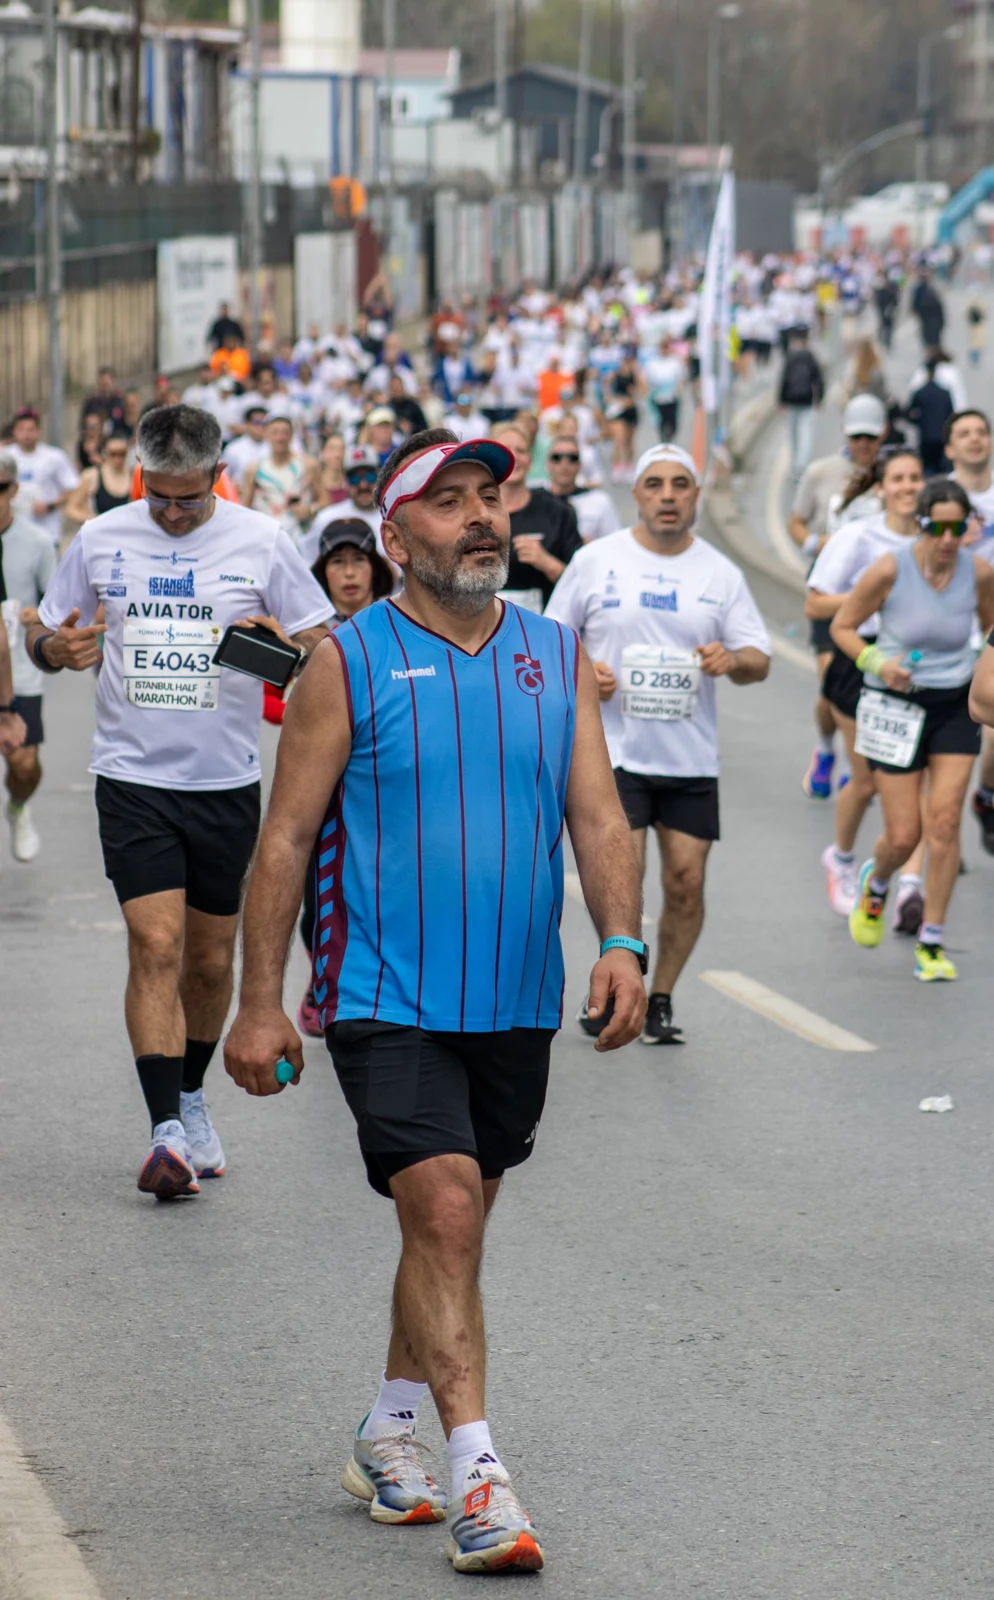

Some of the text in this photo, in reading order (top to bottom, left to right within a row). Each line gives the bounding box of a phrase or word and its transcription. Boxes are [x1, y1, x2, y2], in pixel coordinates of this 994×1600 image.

[126, 602, 214, 621] AVIATOR
[134, 650, 210, 673] E 4043
[391, 664, 437, 680] hummel
[631, 670, 692, 690] D 2836
[175, 683, 198, 692] HALF
[134, 692, 198, 706] MARATHON
